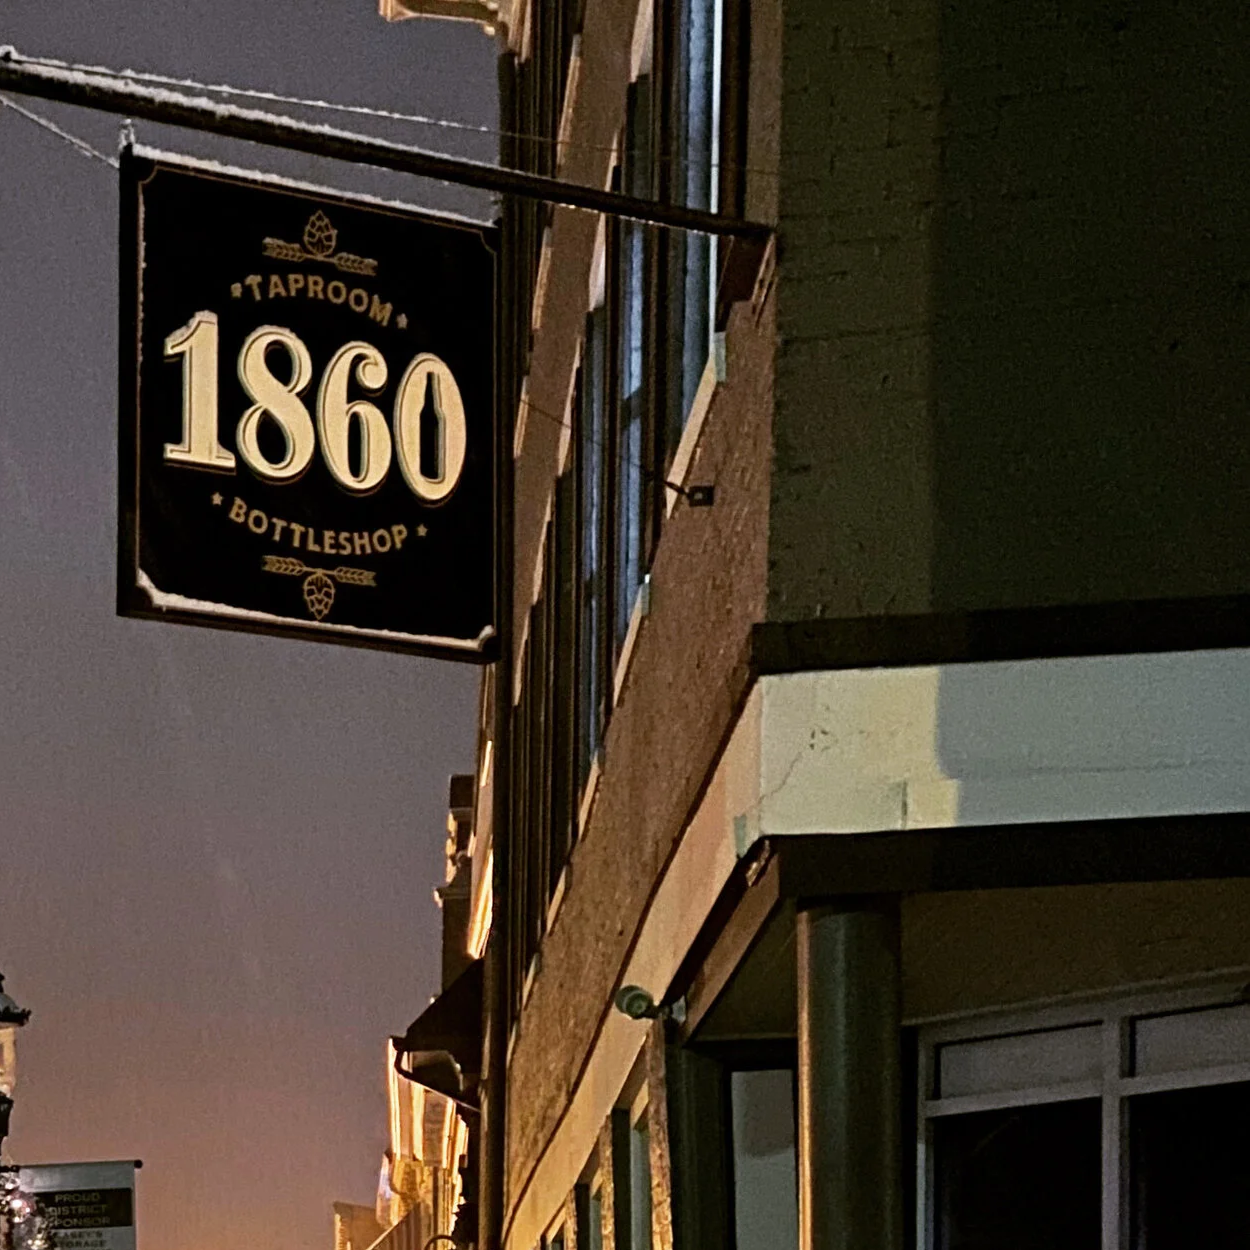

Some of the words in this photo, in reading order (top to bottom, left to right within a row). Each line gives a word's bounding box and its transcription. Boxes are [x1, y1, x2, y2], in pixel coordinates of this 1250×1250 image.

[244, 273, 394, 328] TAPROOM
[162, 309, 468, 505] 1860
[228, 496, 409, 556] BOTTLESHOP
[49, 1204, 108, 1216] DISTRICT
[54, 1192, 101, 1203] PROUD
[50, 1216, 111, 1228] PONSOR
